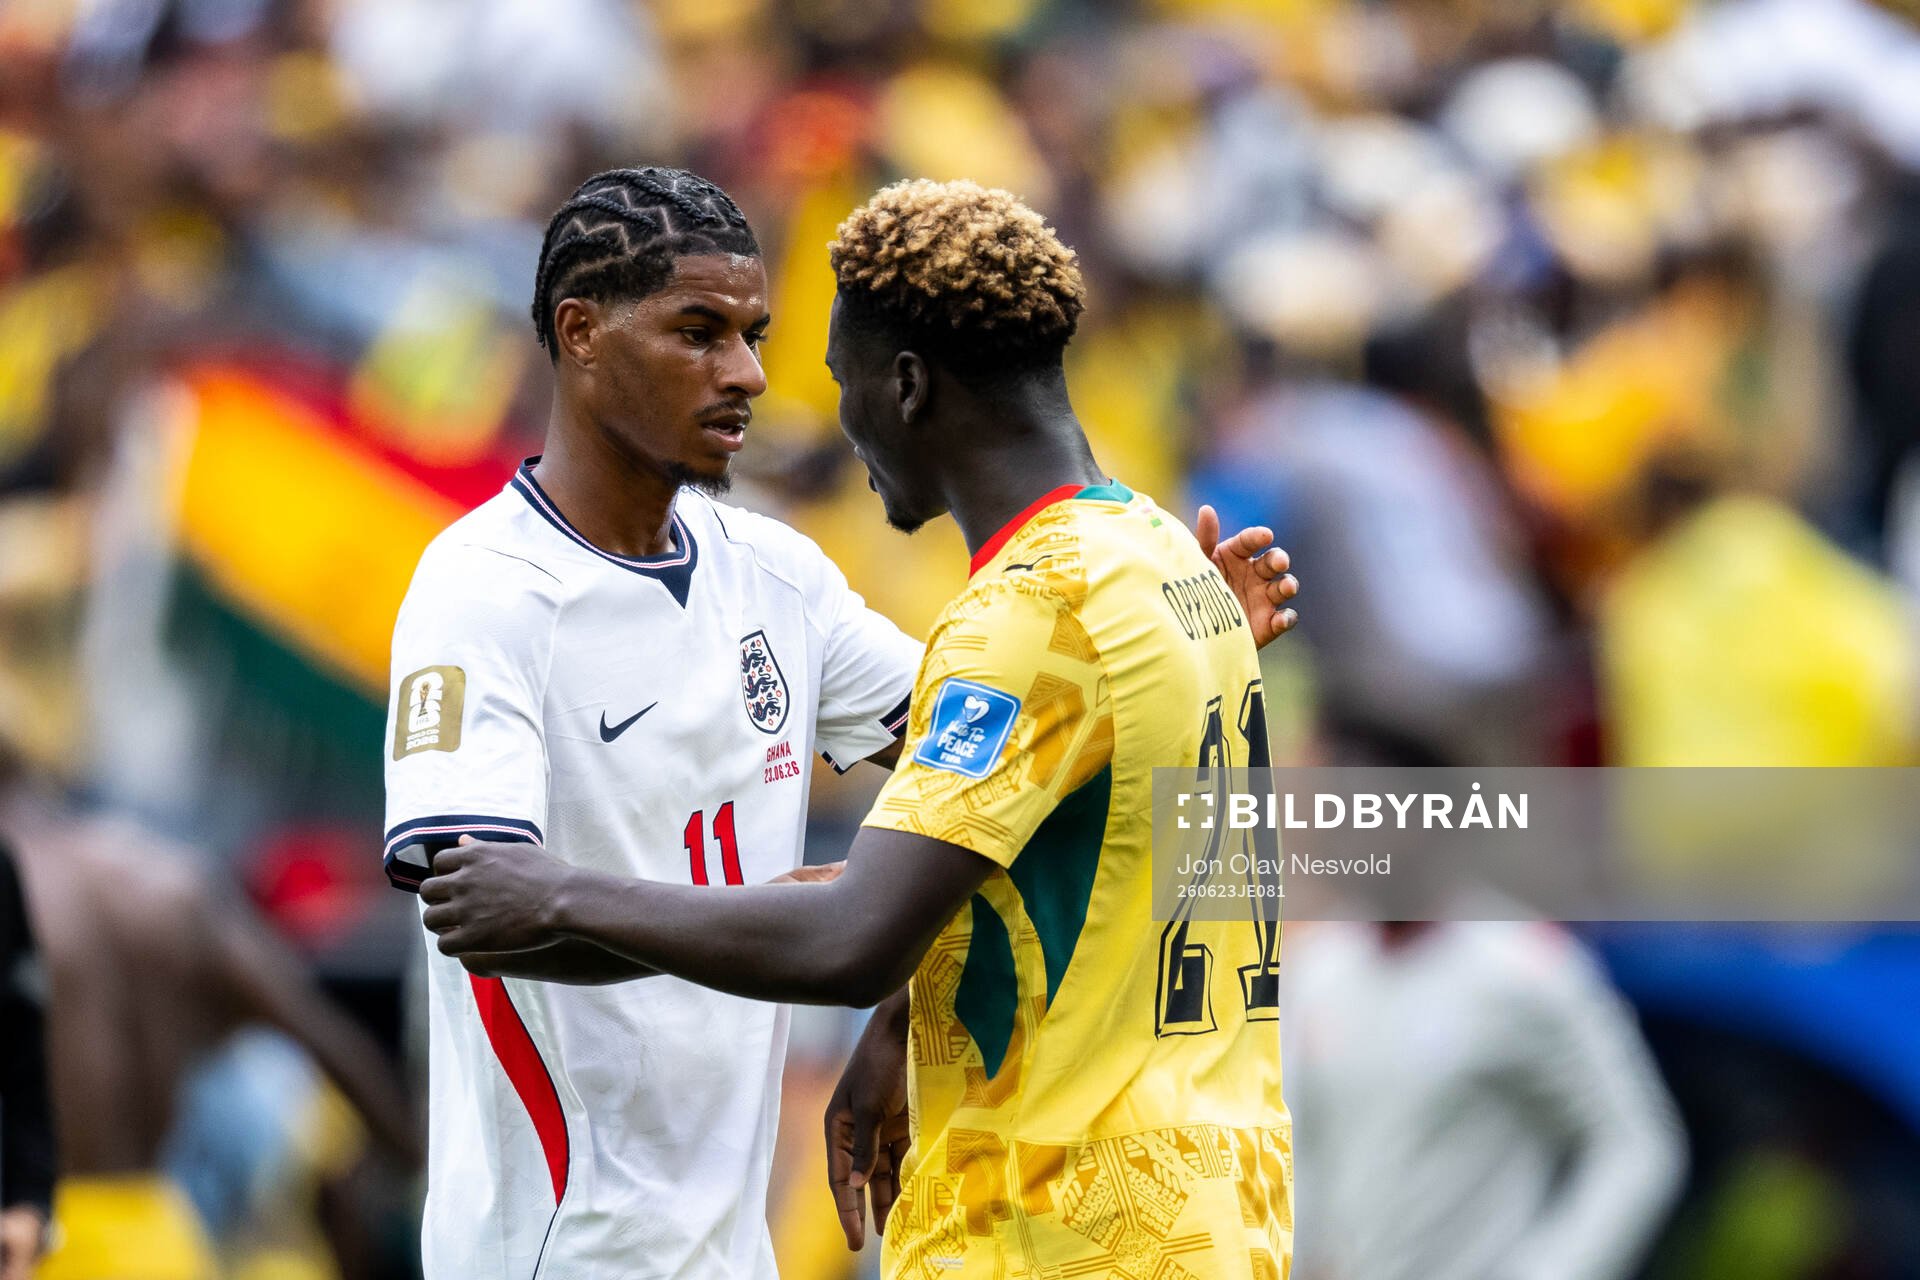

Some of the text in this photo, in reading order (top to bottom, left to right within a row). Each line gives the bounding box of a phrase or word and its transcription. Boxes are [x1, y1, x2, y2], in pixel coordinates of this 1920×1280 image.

[766, 740, 792, 762] GHANA
[936, 731, 979, 759] PEACE
[764, 760, 799, 784] 23.06.26
[684, 800, 744, 886] 11
[1154, 679, 1281, 1040] 21
